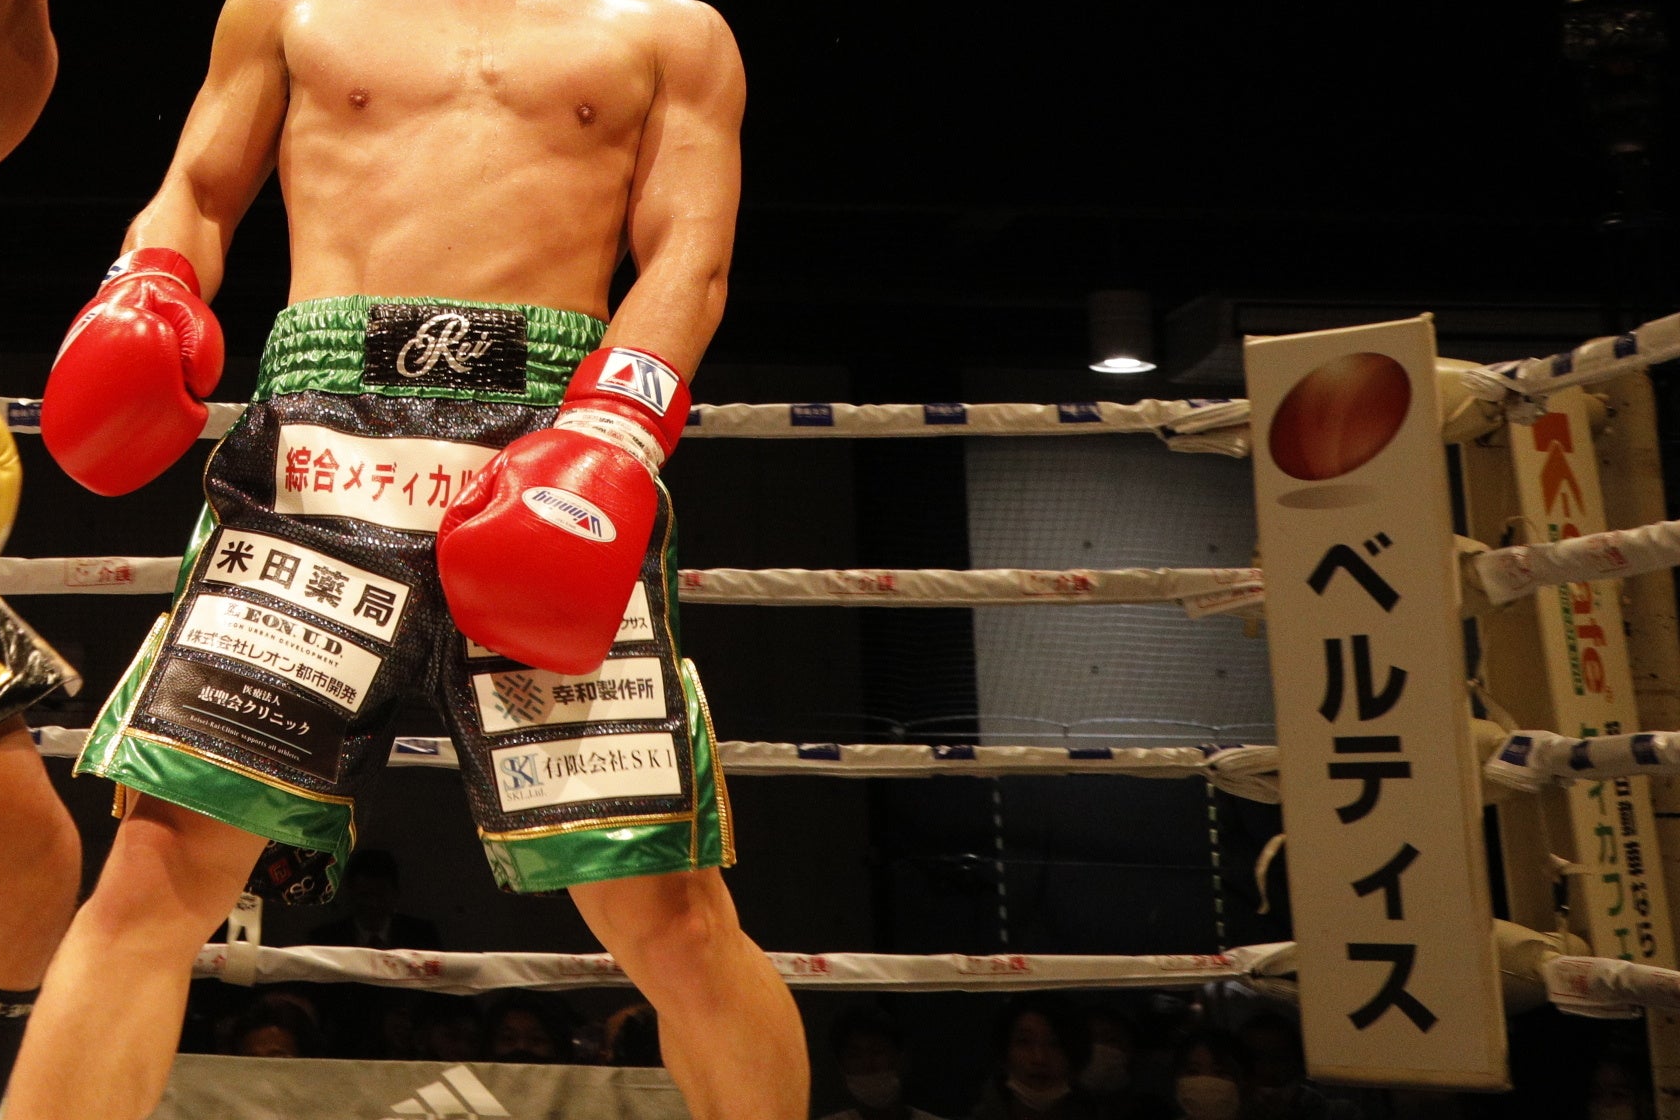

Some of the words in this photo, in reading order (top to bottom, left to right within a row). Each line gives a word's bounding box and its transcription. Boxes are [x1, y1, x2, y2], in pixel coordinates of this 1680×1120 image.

[532, 490, 602, 537] Winning
[1532, 413, 1607, 694] K-afe
[186, 628, 358, 705] 株式会社レオン都市開発
[278, 638, 340, 668] DEVELOPMENT
[242, 685, 281, 706] 医療法人
[552, 678, 654, 705] 幸和製作所
[1307, 531, 1437, 1033] ベルティス
